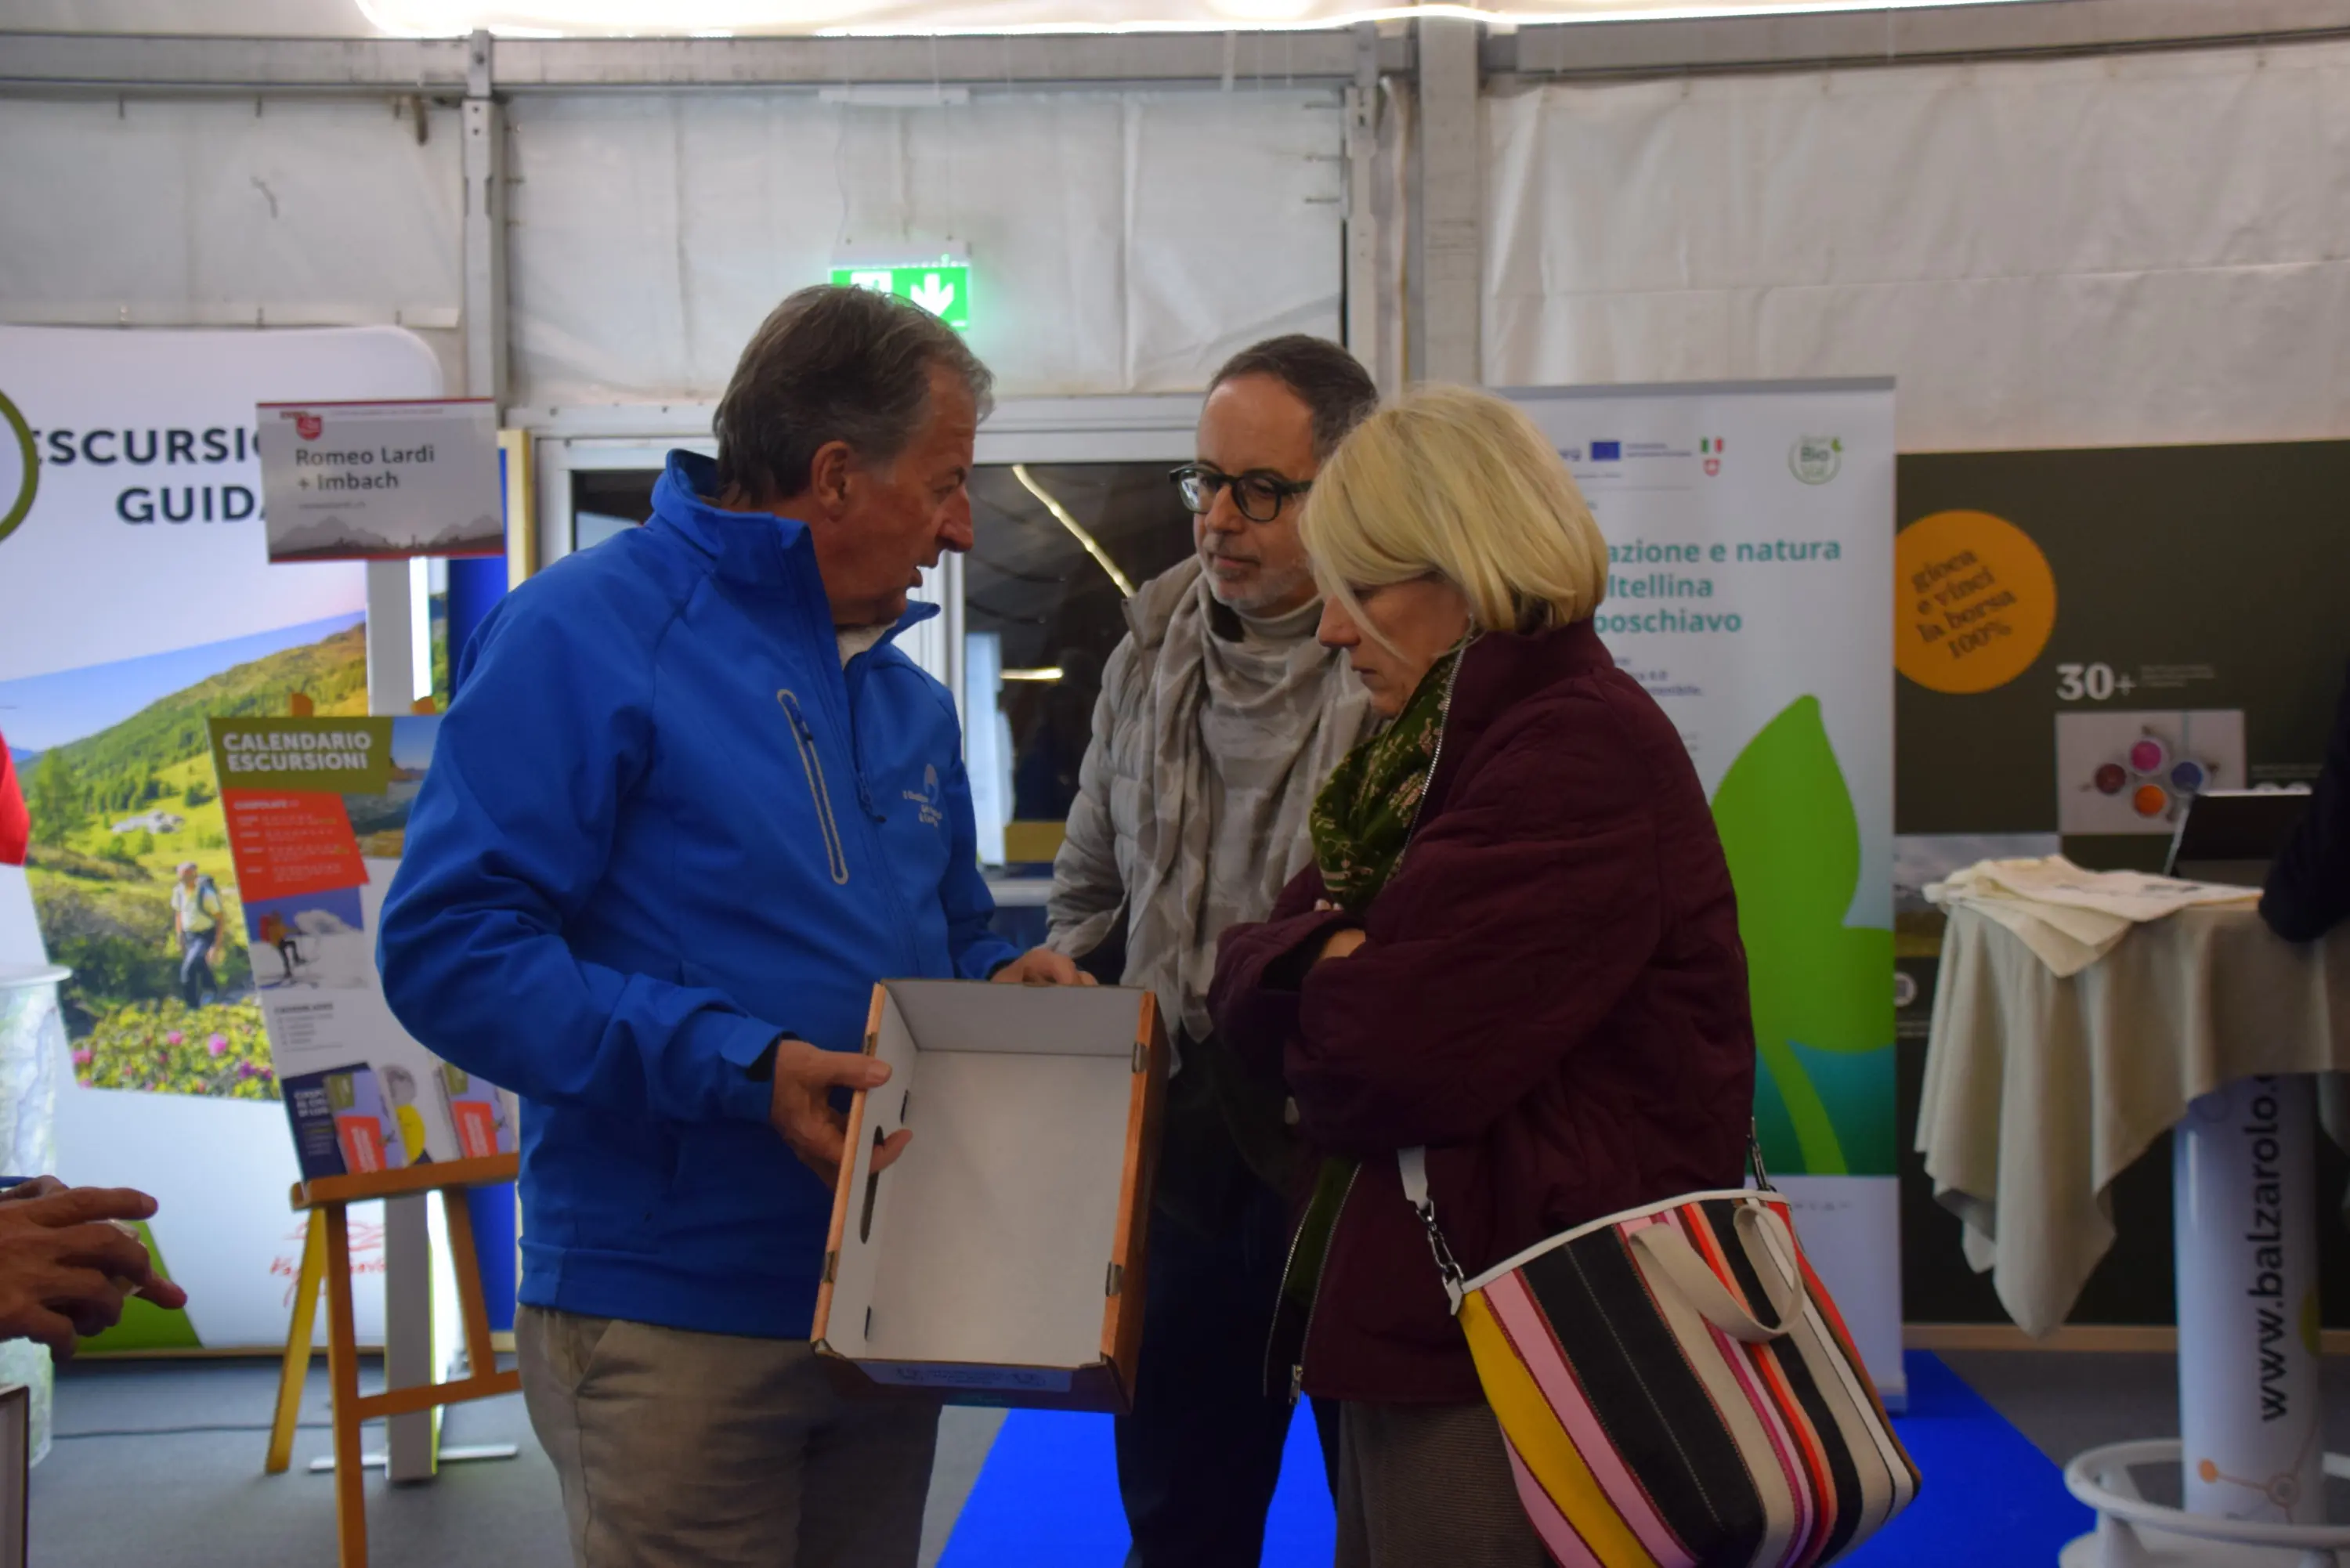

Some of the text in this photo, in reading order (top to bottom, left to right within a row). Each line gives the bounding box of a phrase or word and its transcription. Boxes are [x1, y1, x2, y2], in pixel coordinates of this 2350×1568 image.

[33, 428, 260, 466] SCURSI
[295, 445, 435, 466] Romeo Lardi
[317, 471, 400, 490] Imbach
[116, 484, 266, 525] GUID
[1709, 544, 1727, 563] e
[1737, 539, 1842, 562] natura
[1911, 549, 1979, 594] gioca
[1933, 565, 1995, 606] vinci
[2055, 662, 2137, 701] 30+
[222, 731, 372, 752] CALENDARIO
[227, 752, 369, 772] ESCURSIONI
